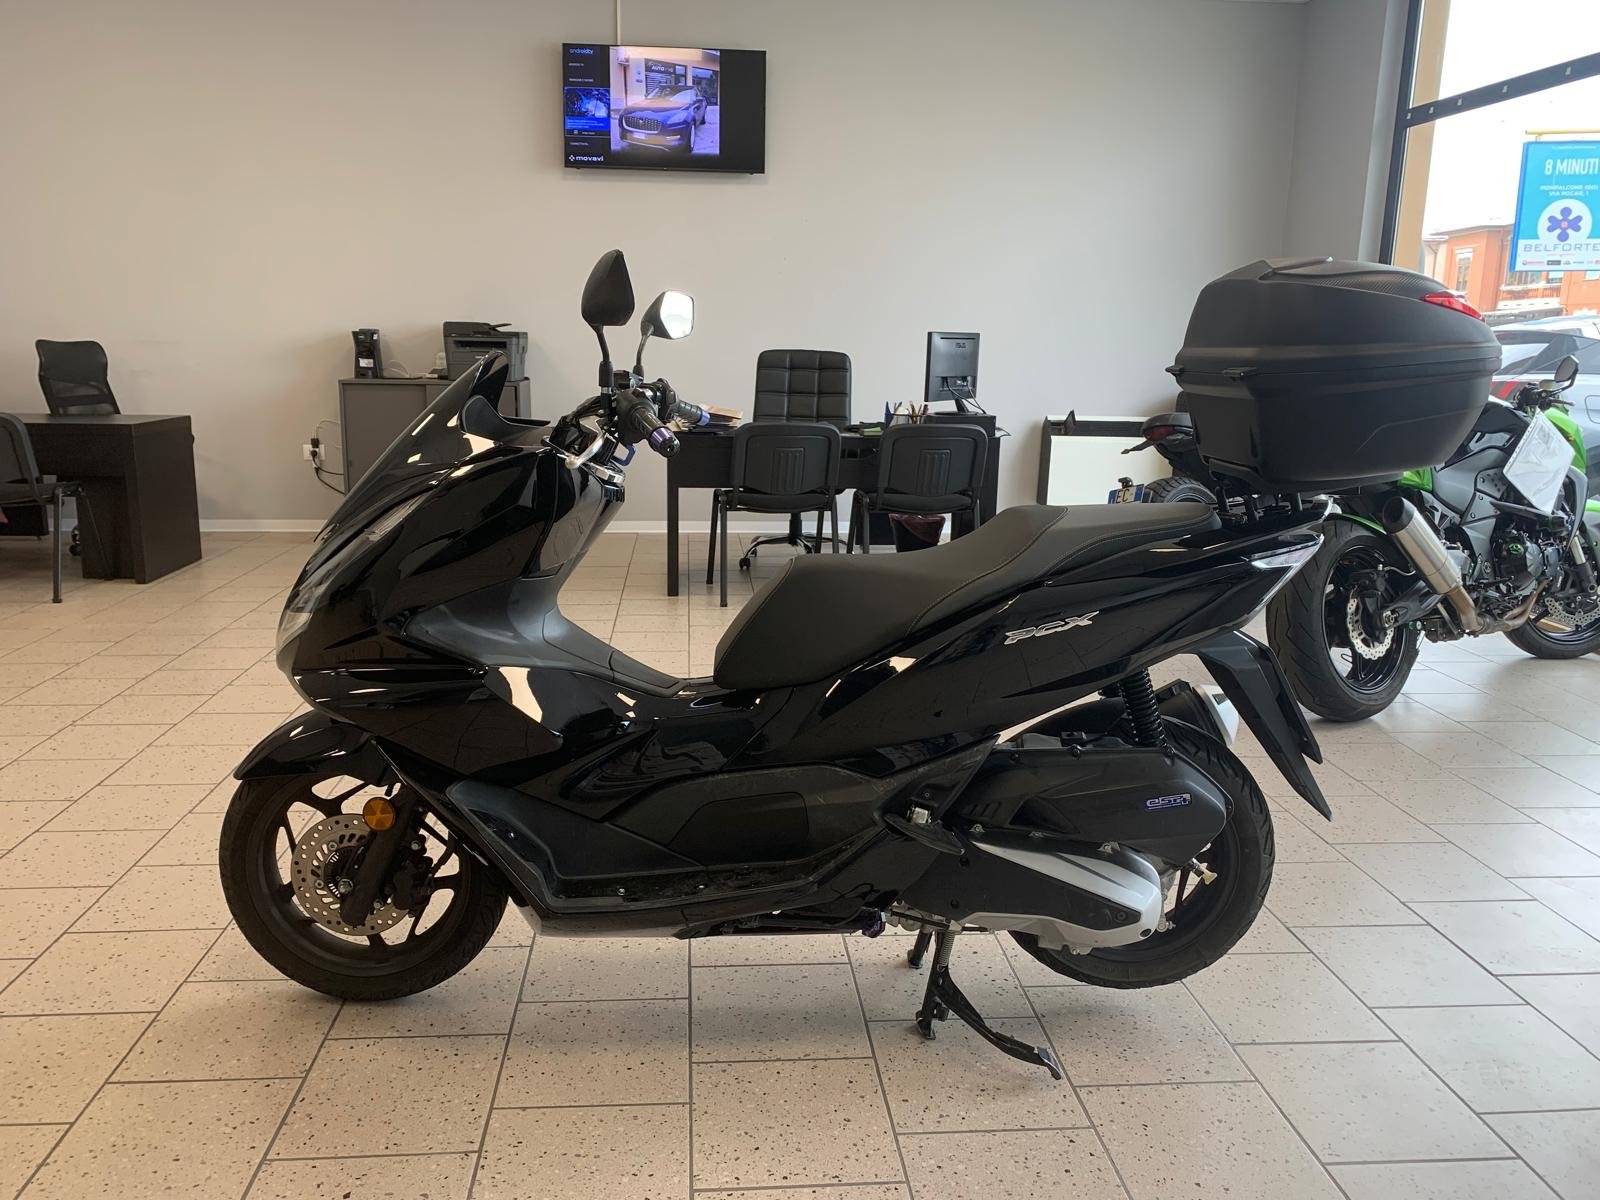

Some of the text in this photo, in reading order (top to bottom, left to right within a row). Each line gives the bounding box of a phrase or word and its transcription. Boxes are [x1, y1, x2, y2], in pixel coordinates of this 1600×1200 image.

[575, 154, 604, 162] movavi
[1544, 158, 1599, 175] 8 MINUTI
[1523, 243, 1600, 252] BELFORTE
[1004, 610, 1100, 645] PCX
